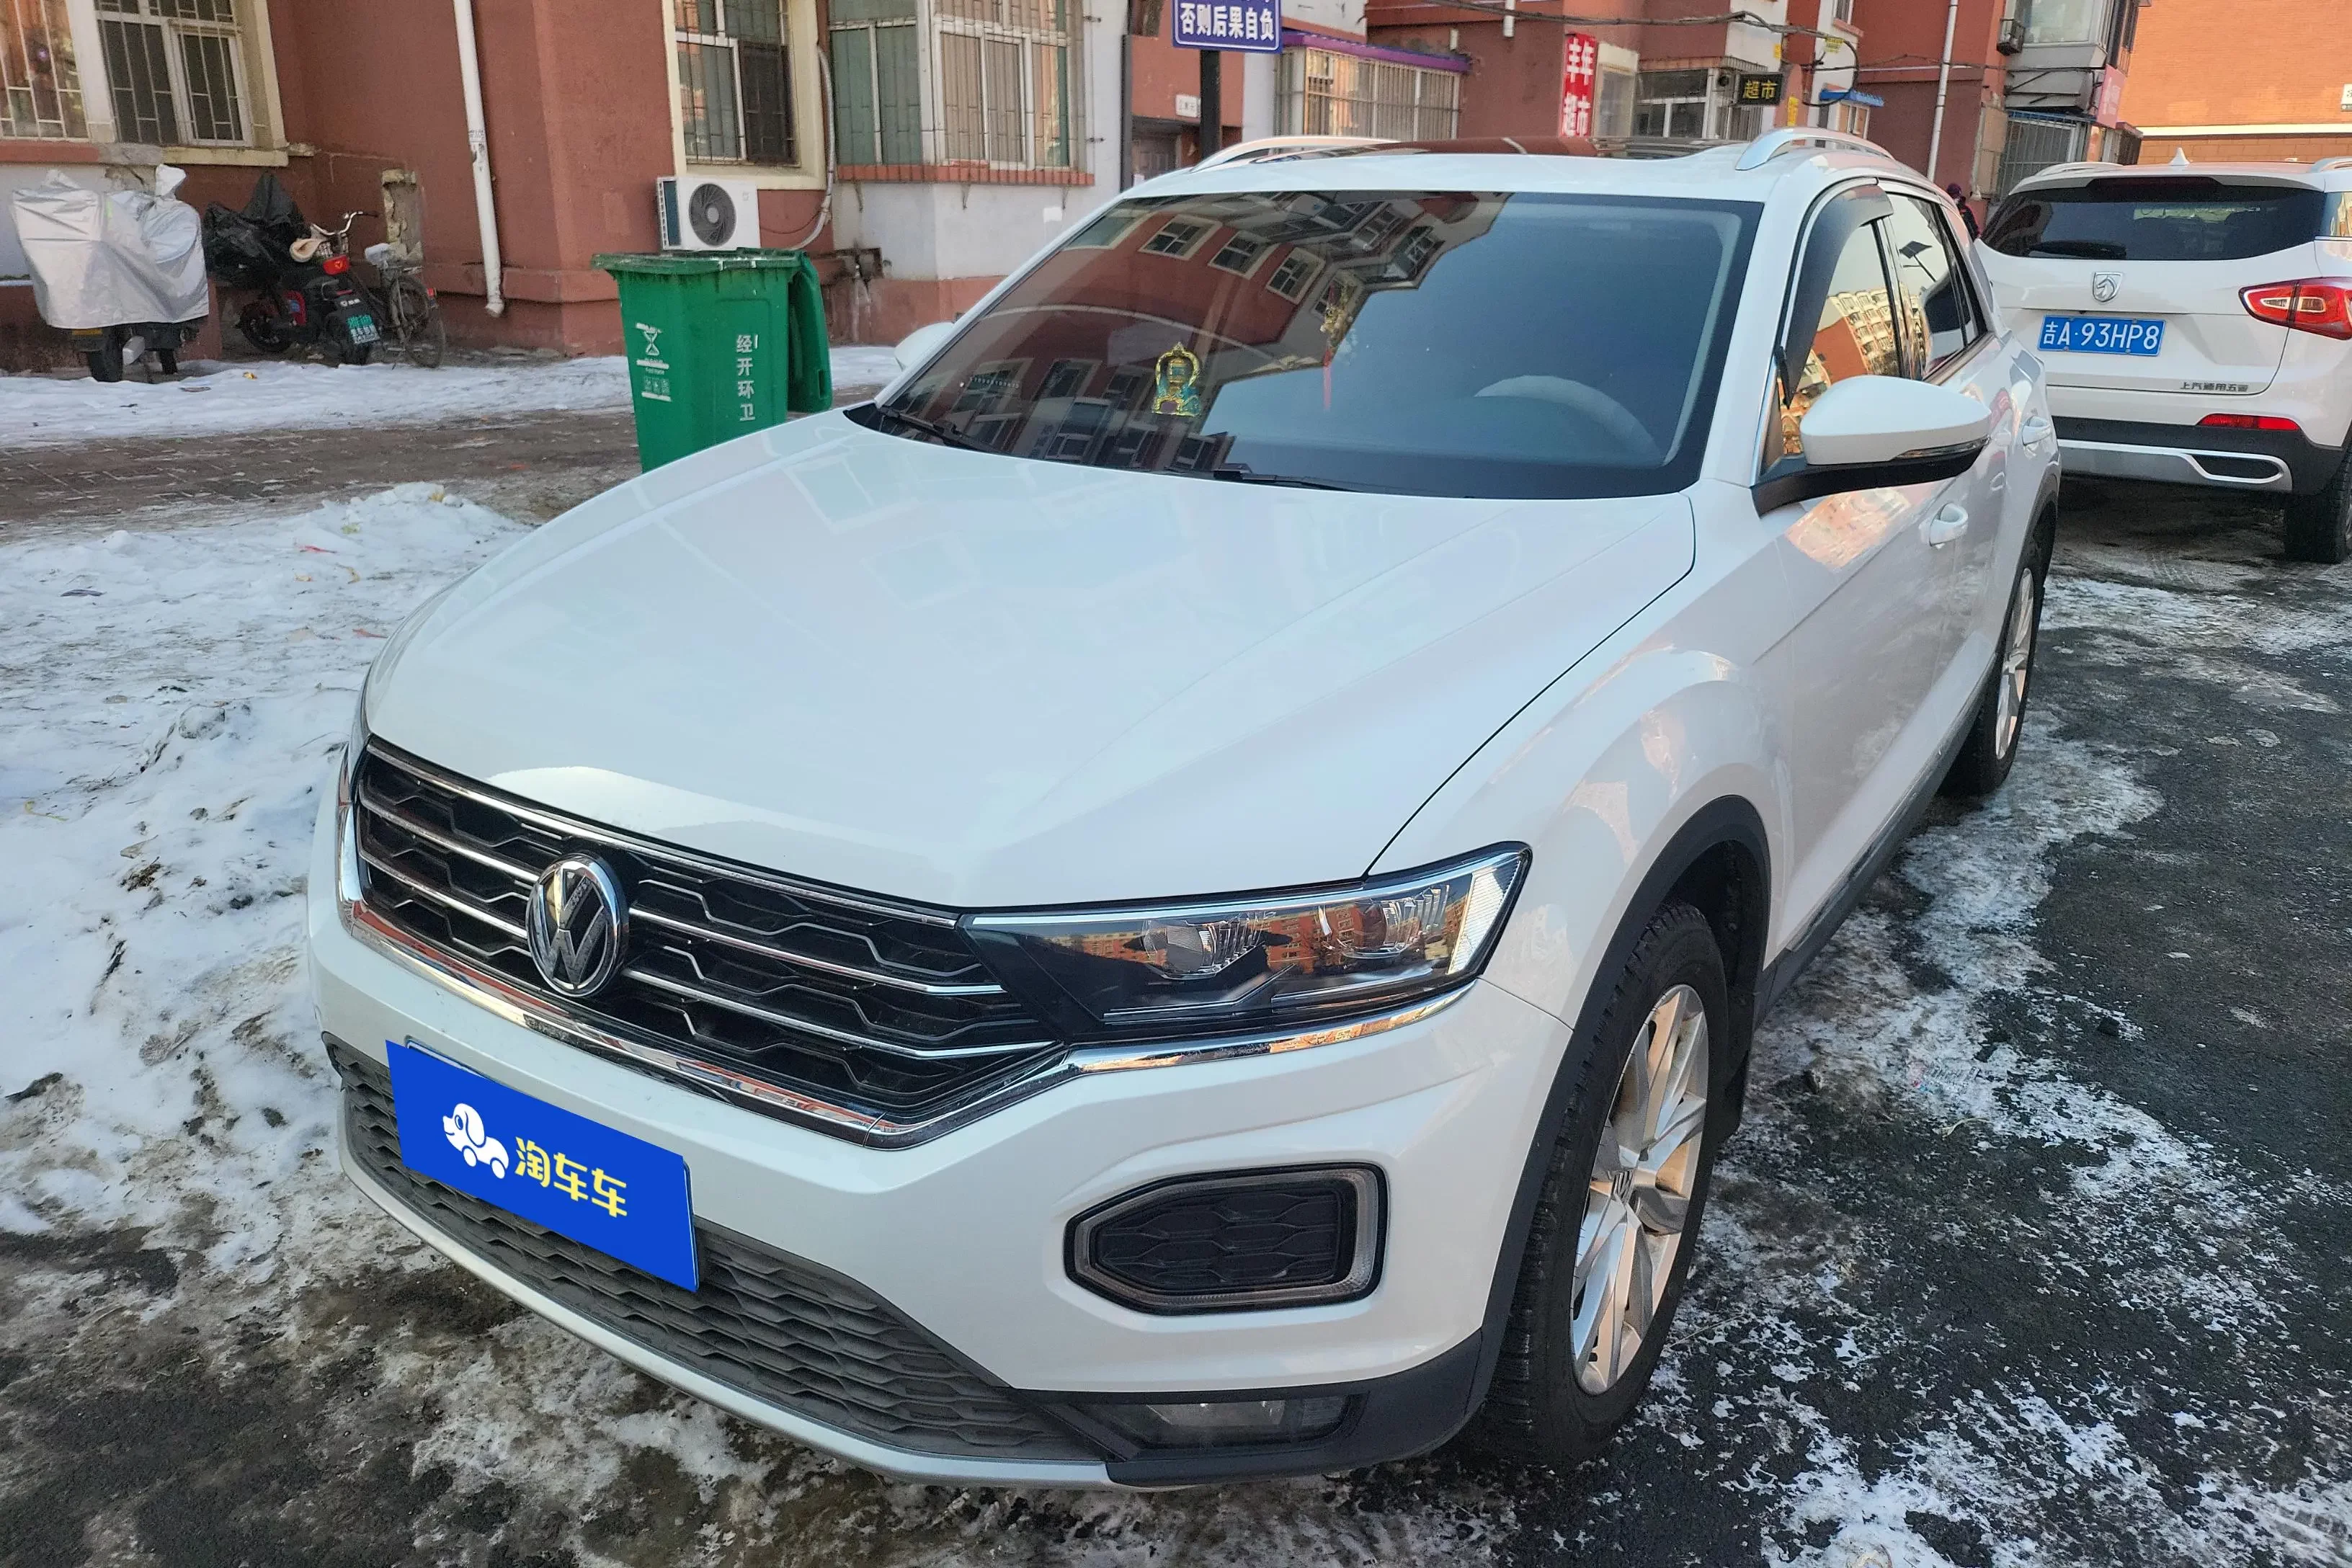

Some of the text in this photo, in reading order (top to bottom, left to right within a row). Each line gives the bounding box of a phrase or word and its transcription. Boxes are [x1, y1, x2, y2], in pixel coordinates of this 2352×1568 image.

[1180, 3, 1275, 41] 否则后果自负
[1742, 80, 1778, 99] 超市
[1562, 92, 1591, 138] 超市
[736, 334, 755, 421] 经开环卫
